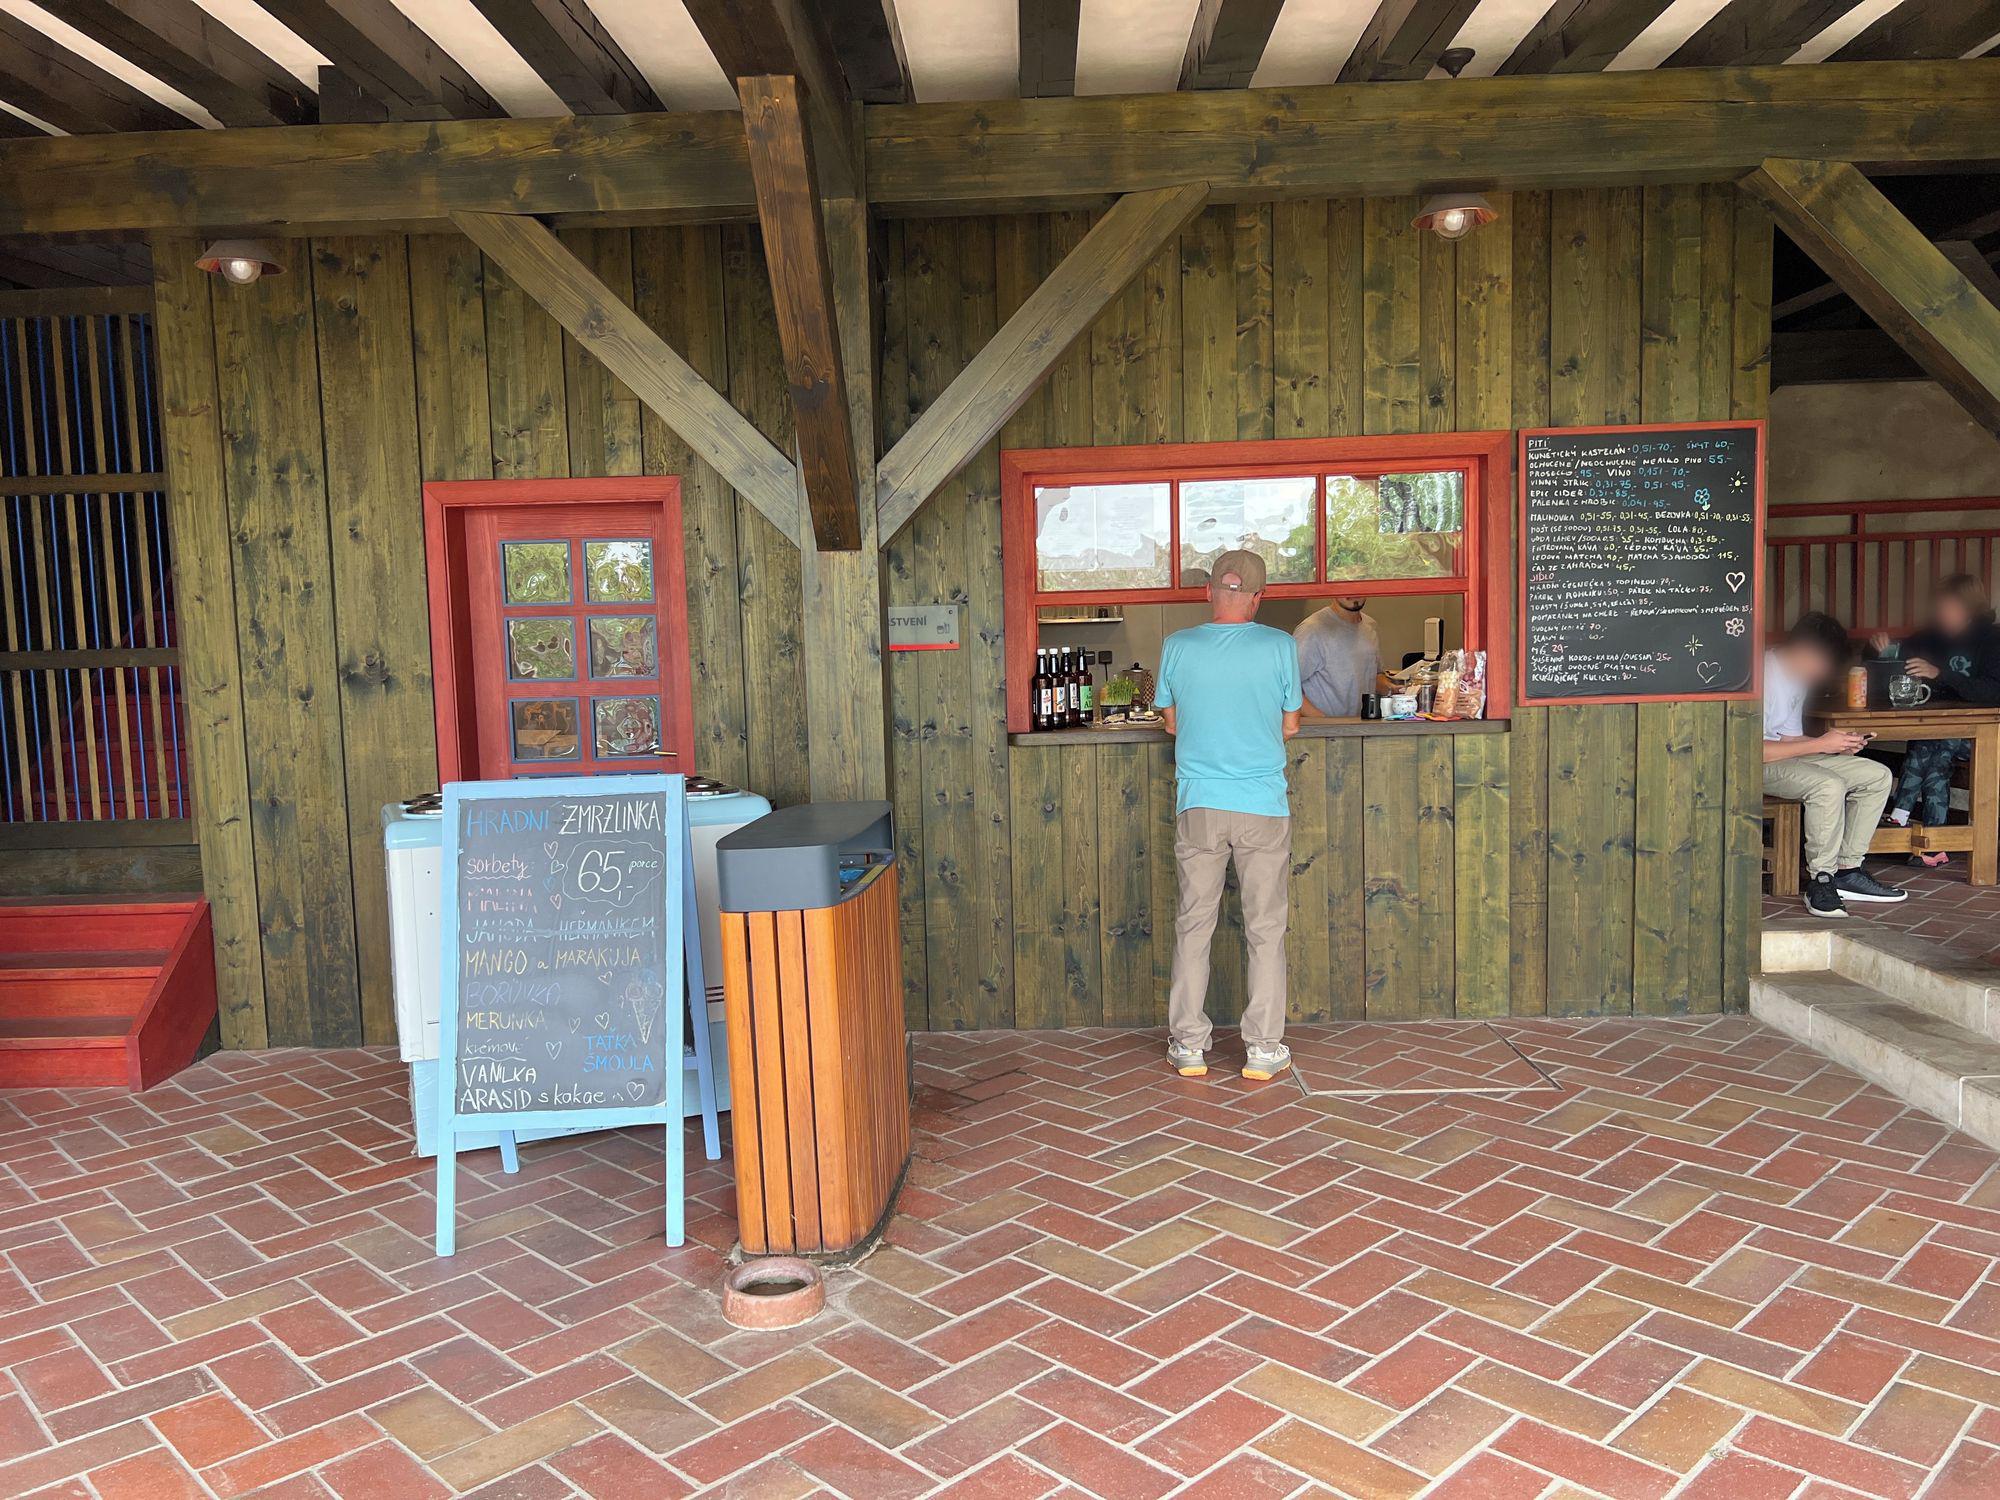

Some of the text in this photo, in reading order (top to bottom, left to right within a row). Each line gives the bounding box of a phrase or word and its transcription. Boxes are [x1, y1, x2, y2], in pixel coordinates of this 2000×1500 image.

[1530, 489, 1548, 497] EPIC
[1530, 513, 1575, 521] MALINOVKA
[889, 616, 927, 627] STVENÍ
[558, 800, 661, 835] ZMRZLINKA
[467, 852, 529, 881] sorbety
[629, 859, 658, 874] porce
[465, 949, 528, 978] MANGO
[538, 1092, 549, 1103] s
